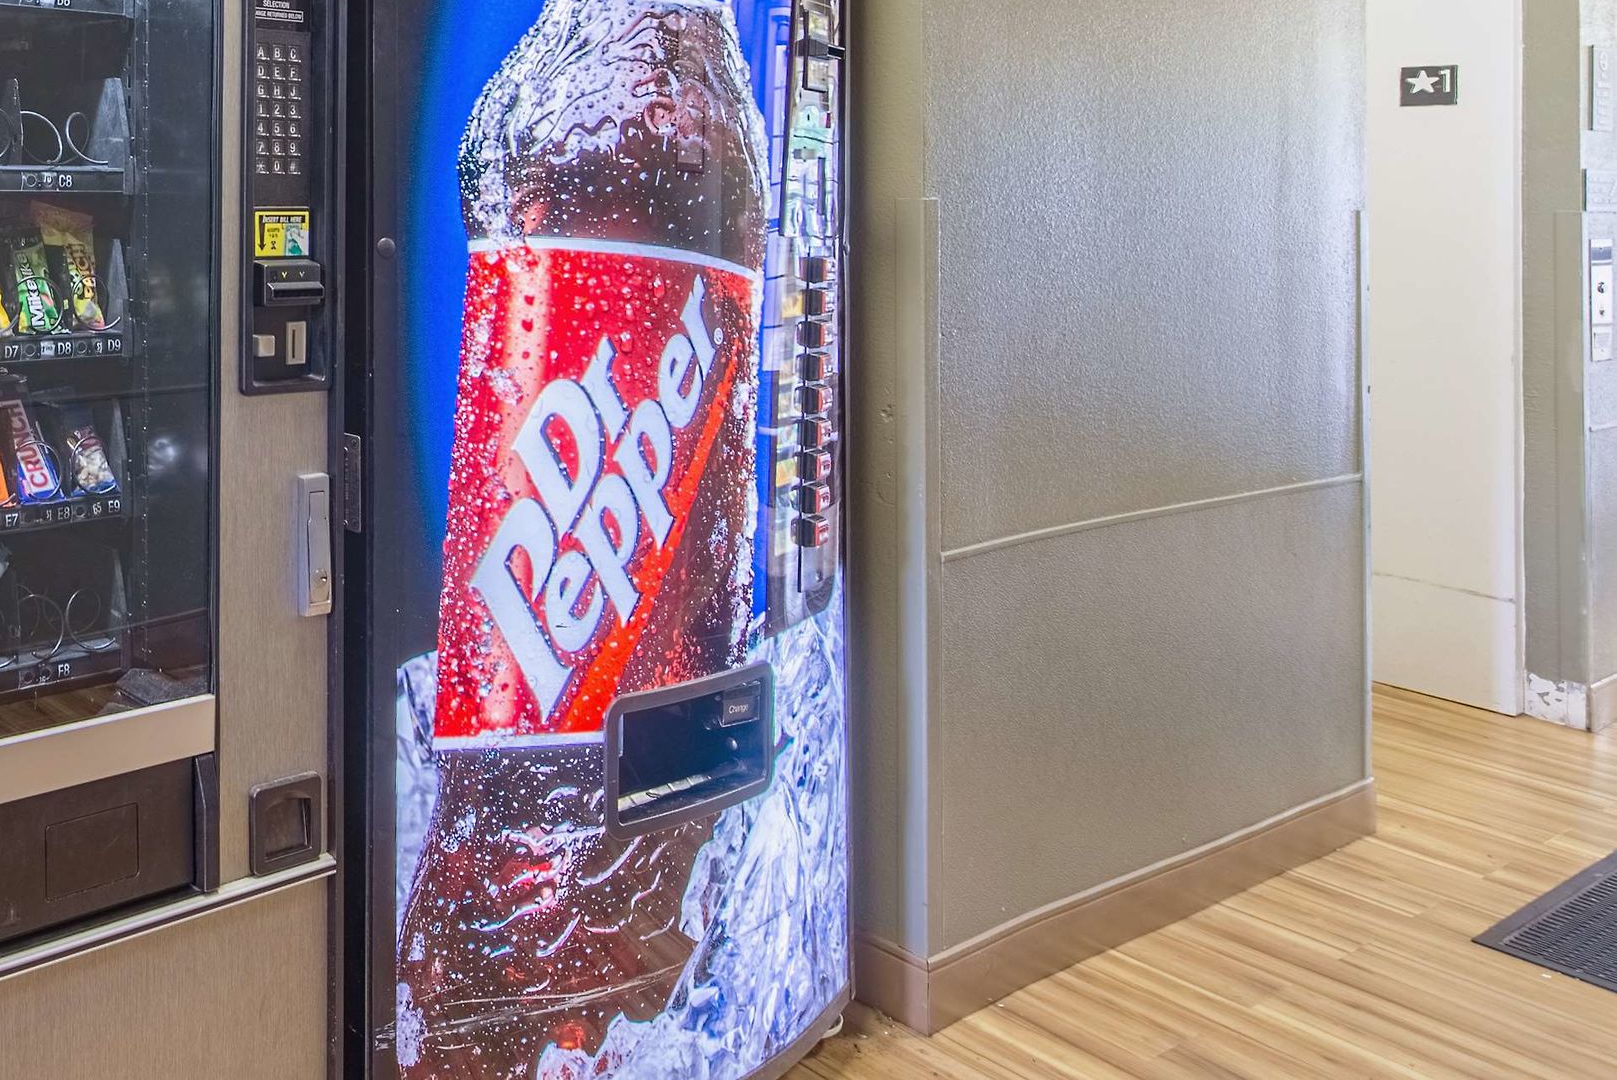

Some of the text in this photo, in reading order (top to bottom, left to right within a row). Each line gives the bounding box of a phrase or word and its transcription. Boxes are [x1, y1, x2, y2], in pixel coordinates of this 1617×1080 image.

[263, 0, 290, 9] SELECTION
[257, 47, 296, 59] A B C
[258, 65, 296, 78] D E F
[1439, 69, 1451, 93] 1
[257, 85, 296, 97] G H J
[258, 104, 296, 115] 1 2 3
[257, 123, 296, 134] 4 5 6
[274, 142, 280, 153] 8
[290, 143, 296, 153] 9
[274, 161, 280, 171] 0
[59, 174, 72, 187] C8
[58, 342, 72, 355] D8
[107, 339, 121, 351] D9
[4, 346, 19, 360] D7
[511, 336, 630, 534] Dr
[470, 274, 719, 724] Pepper
[108, 500, 121, 512] E9
[57, 508, 71, 520] E8
[5, 514, 19, 527] E7
[57, 664, 72, 677] F8
[728, 703, 749, 714] Change
